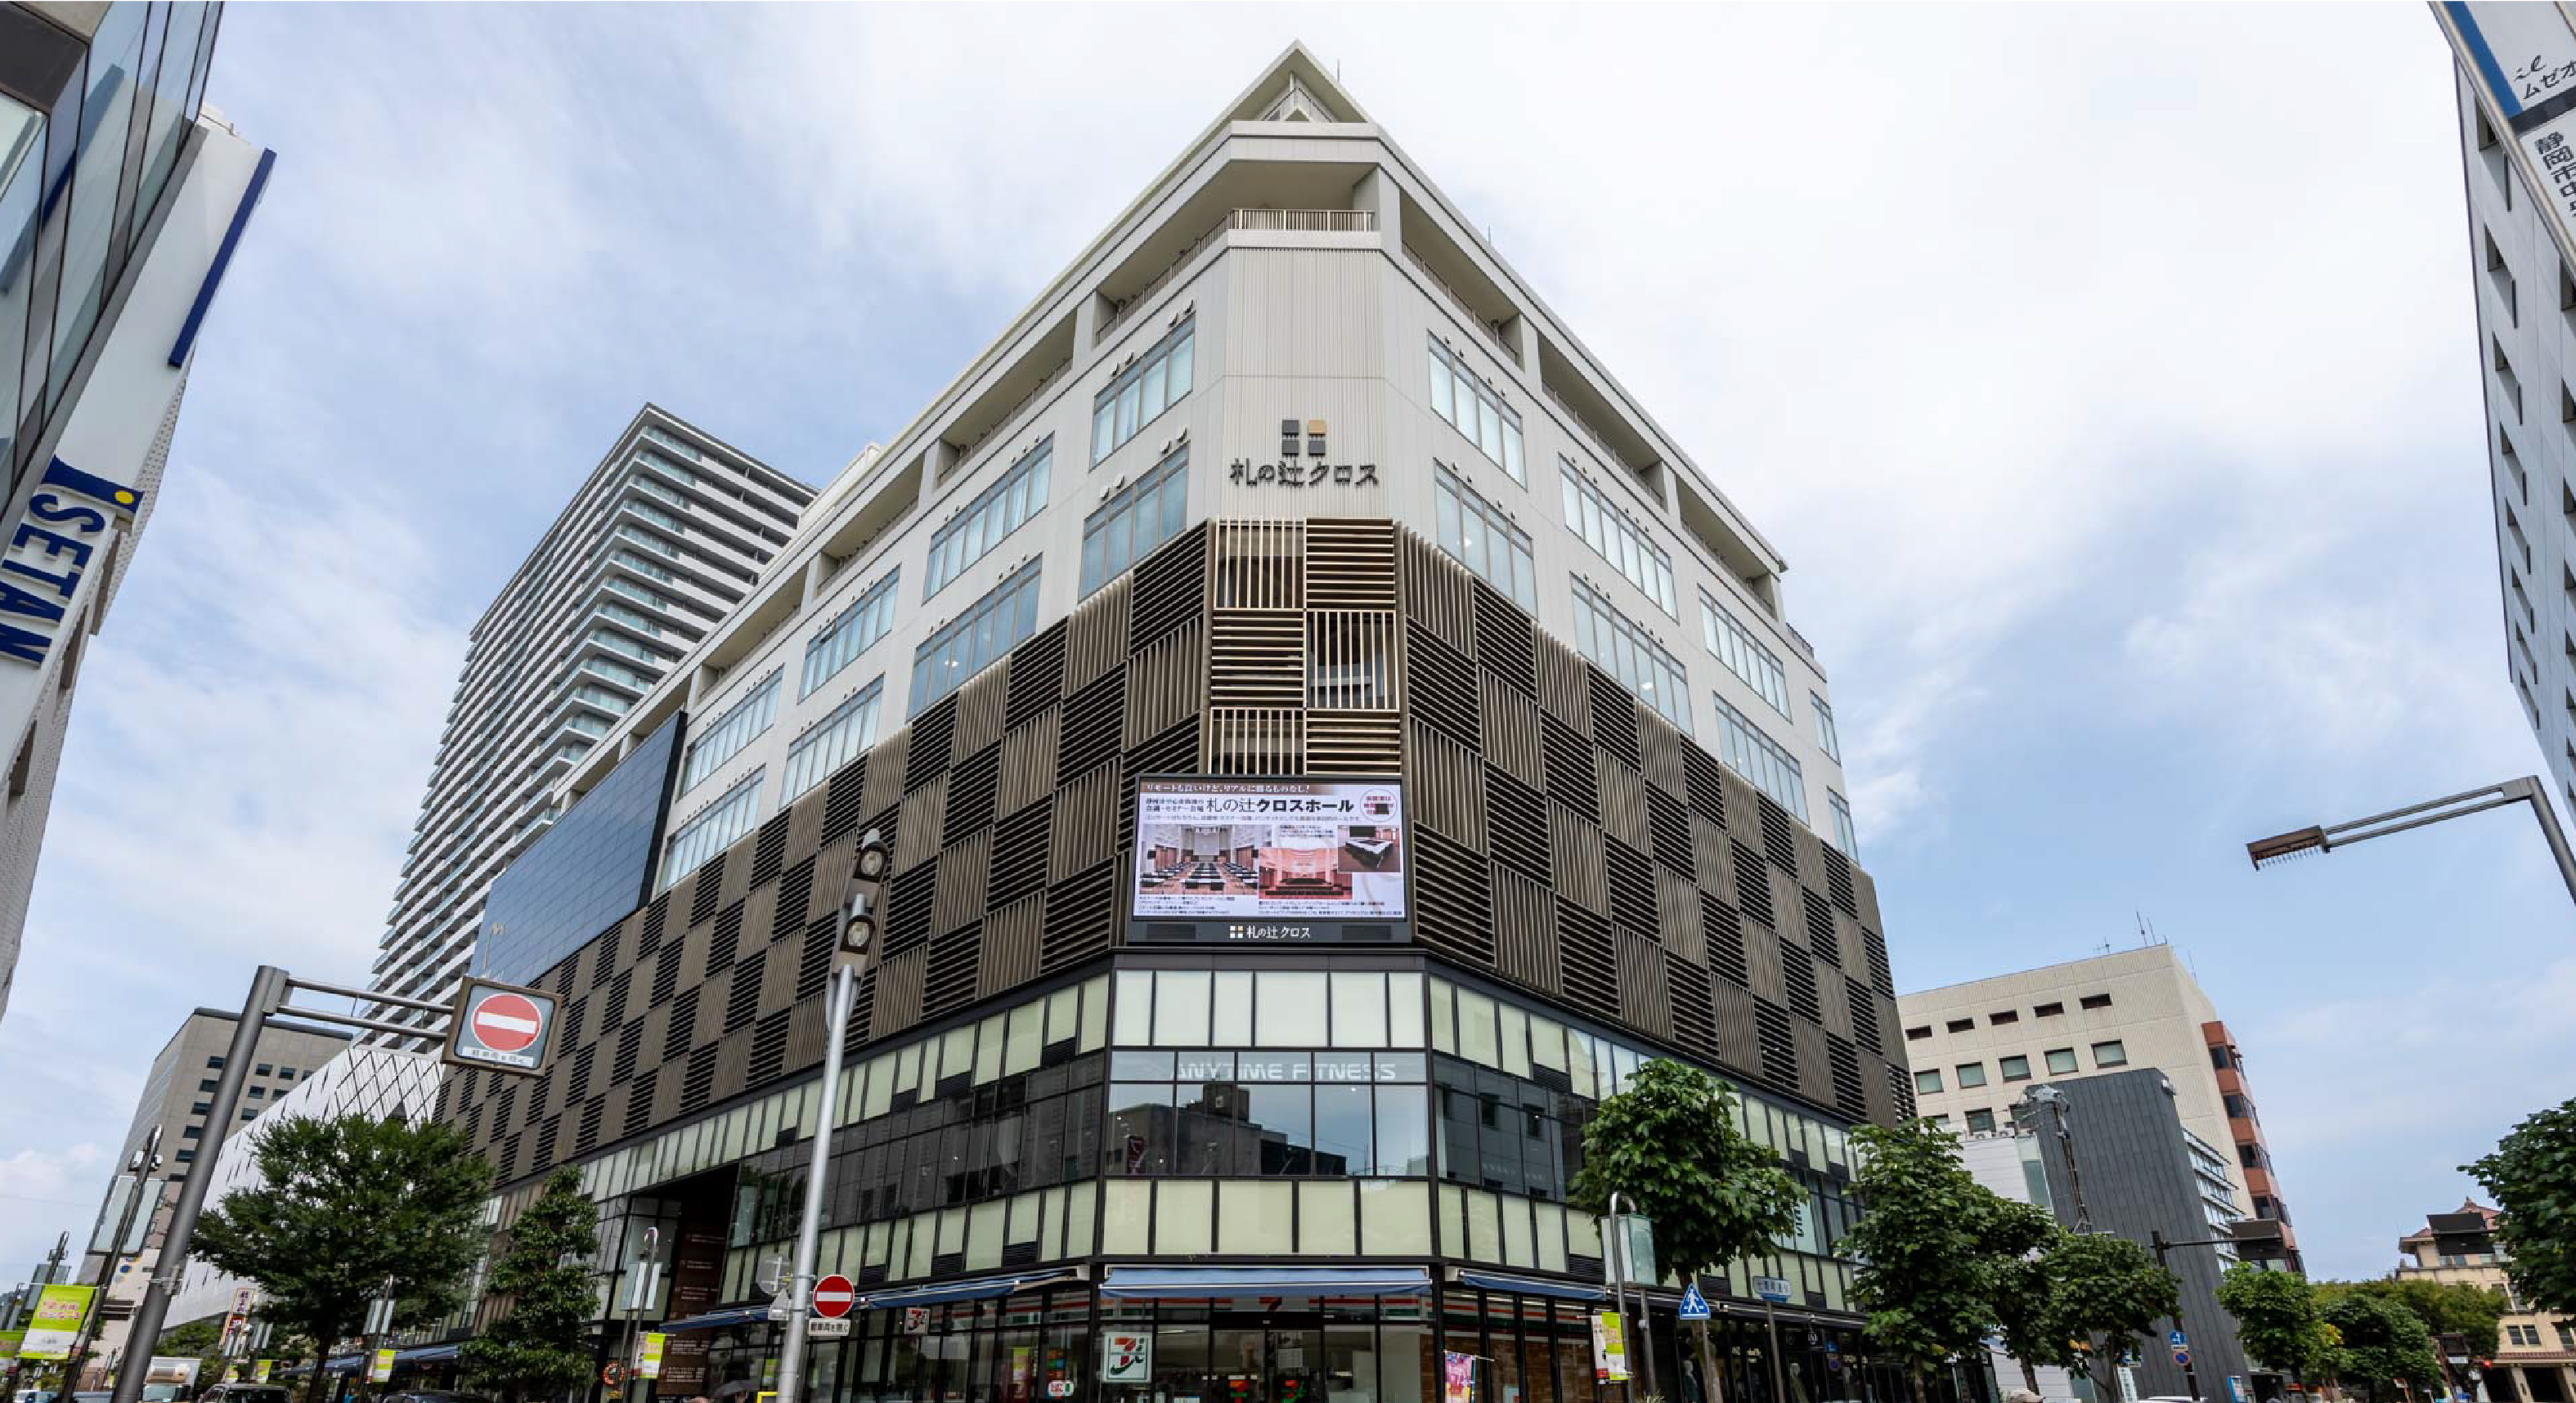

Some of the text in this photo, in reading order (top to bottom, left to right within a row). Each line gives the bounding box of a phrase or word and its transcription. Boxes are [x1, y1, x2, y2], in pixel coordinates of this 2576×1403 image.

[2535, 132, 2576, 217] 静岡市中
[1230, 458, 1380, 486] 札の辻クロス
[1206, 798, 1355, 813] 札の辻クロスホール
[1246, 926, 1310, 939] 札の辻クロス
[1170, 1063, 1282, 1080] ANYTIME
